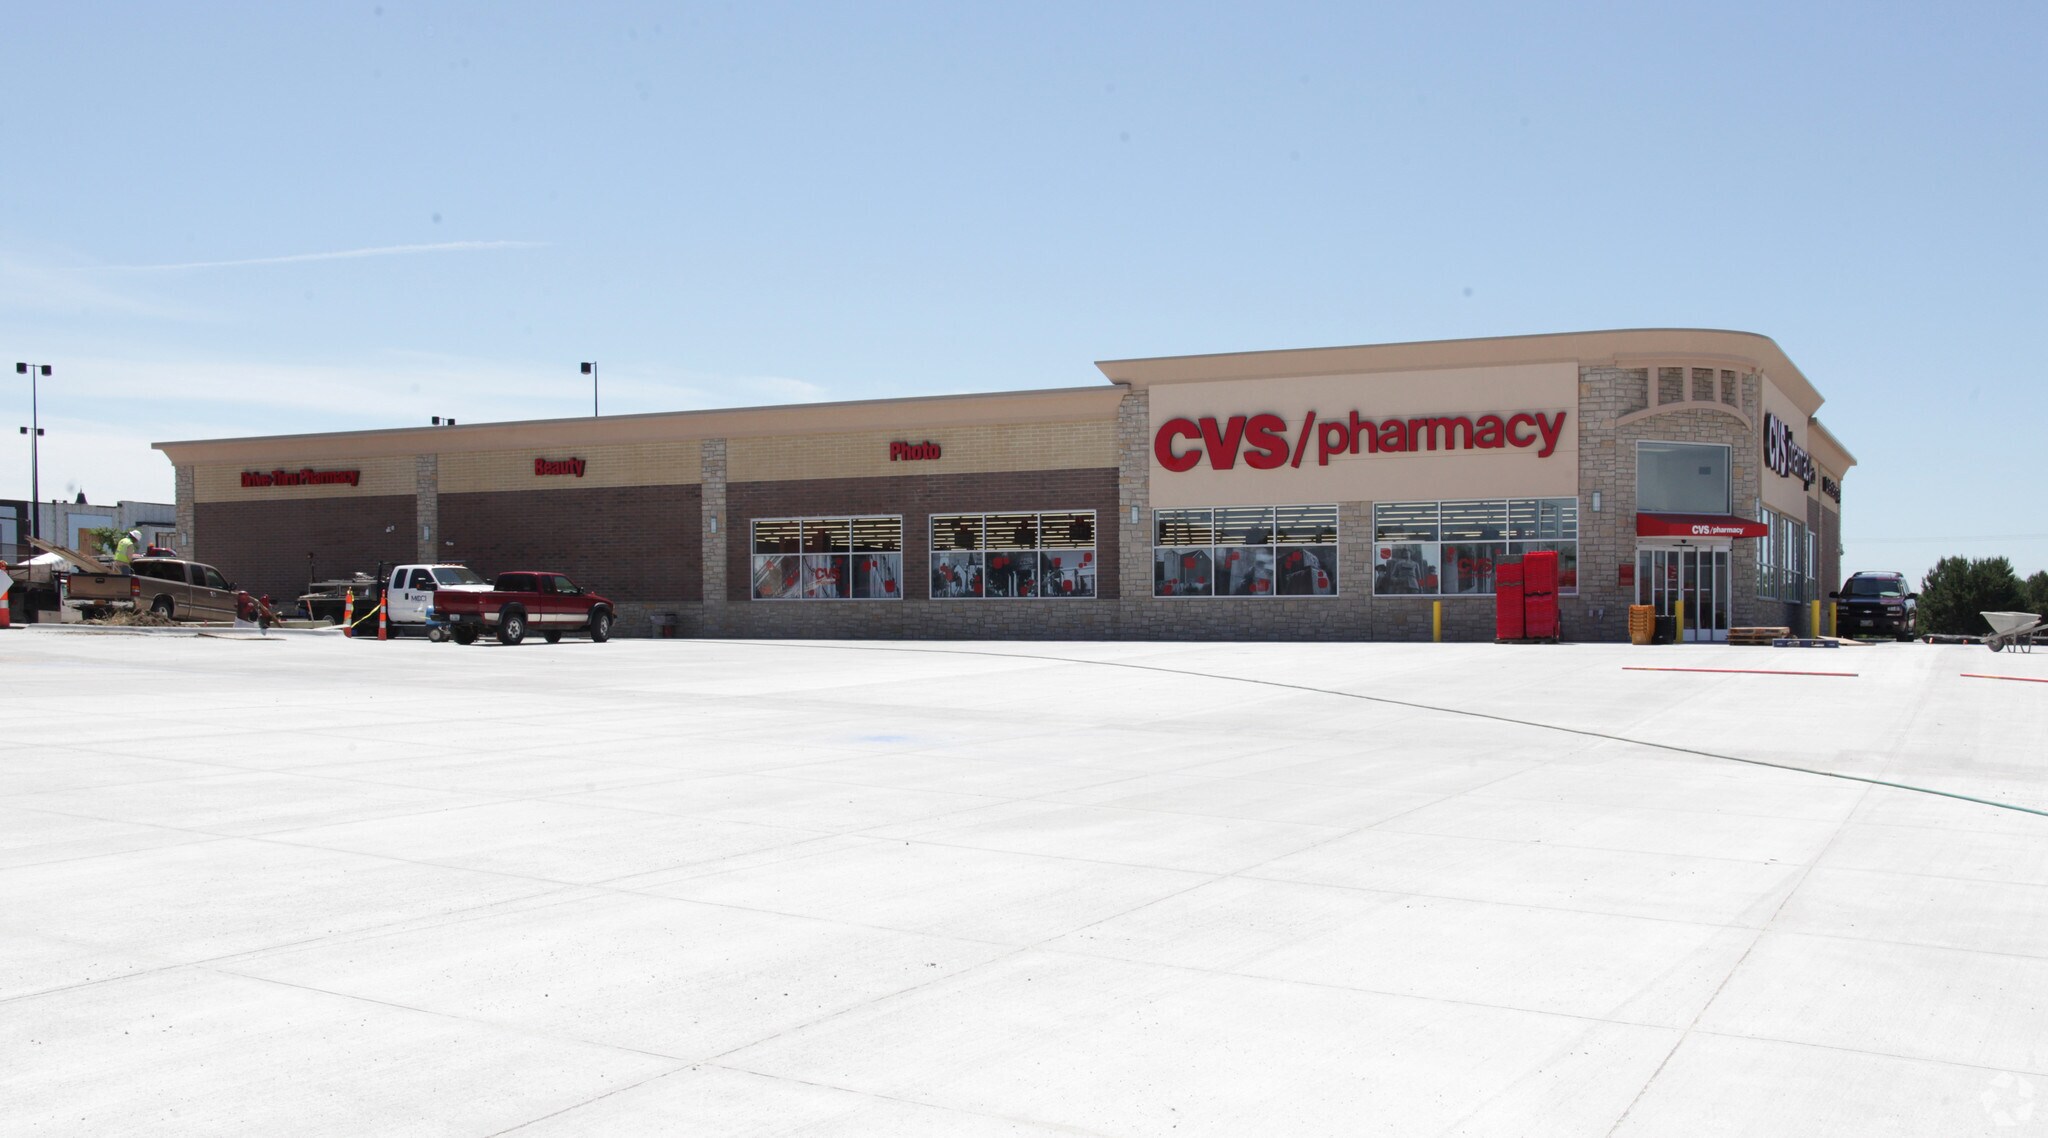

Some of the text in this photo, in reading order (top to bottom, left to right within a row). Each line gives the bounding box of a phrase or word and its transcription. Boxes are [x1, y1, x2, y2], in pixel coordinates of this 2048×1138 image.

[890, 441, 941, 461] Photo
[535, 457, 586, 477] Beauty
[241, 468, 360, 487] Drive-Thru Pharmacy
[815, 567, 840, 580] CVS
